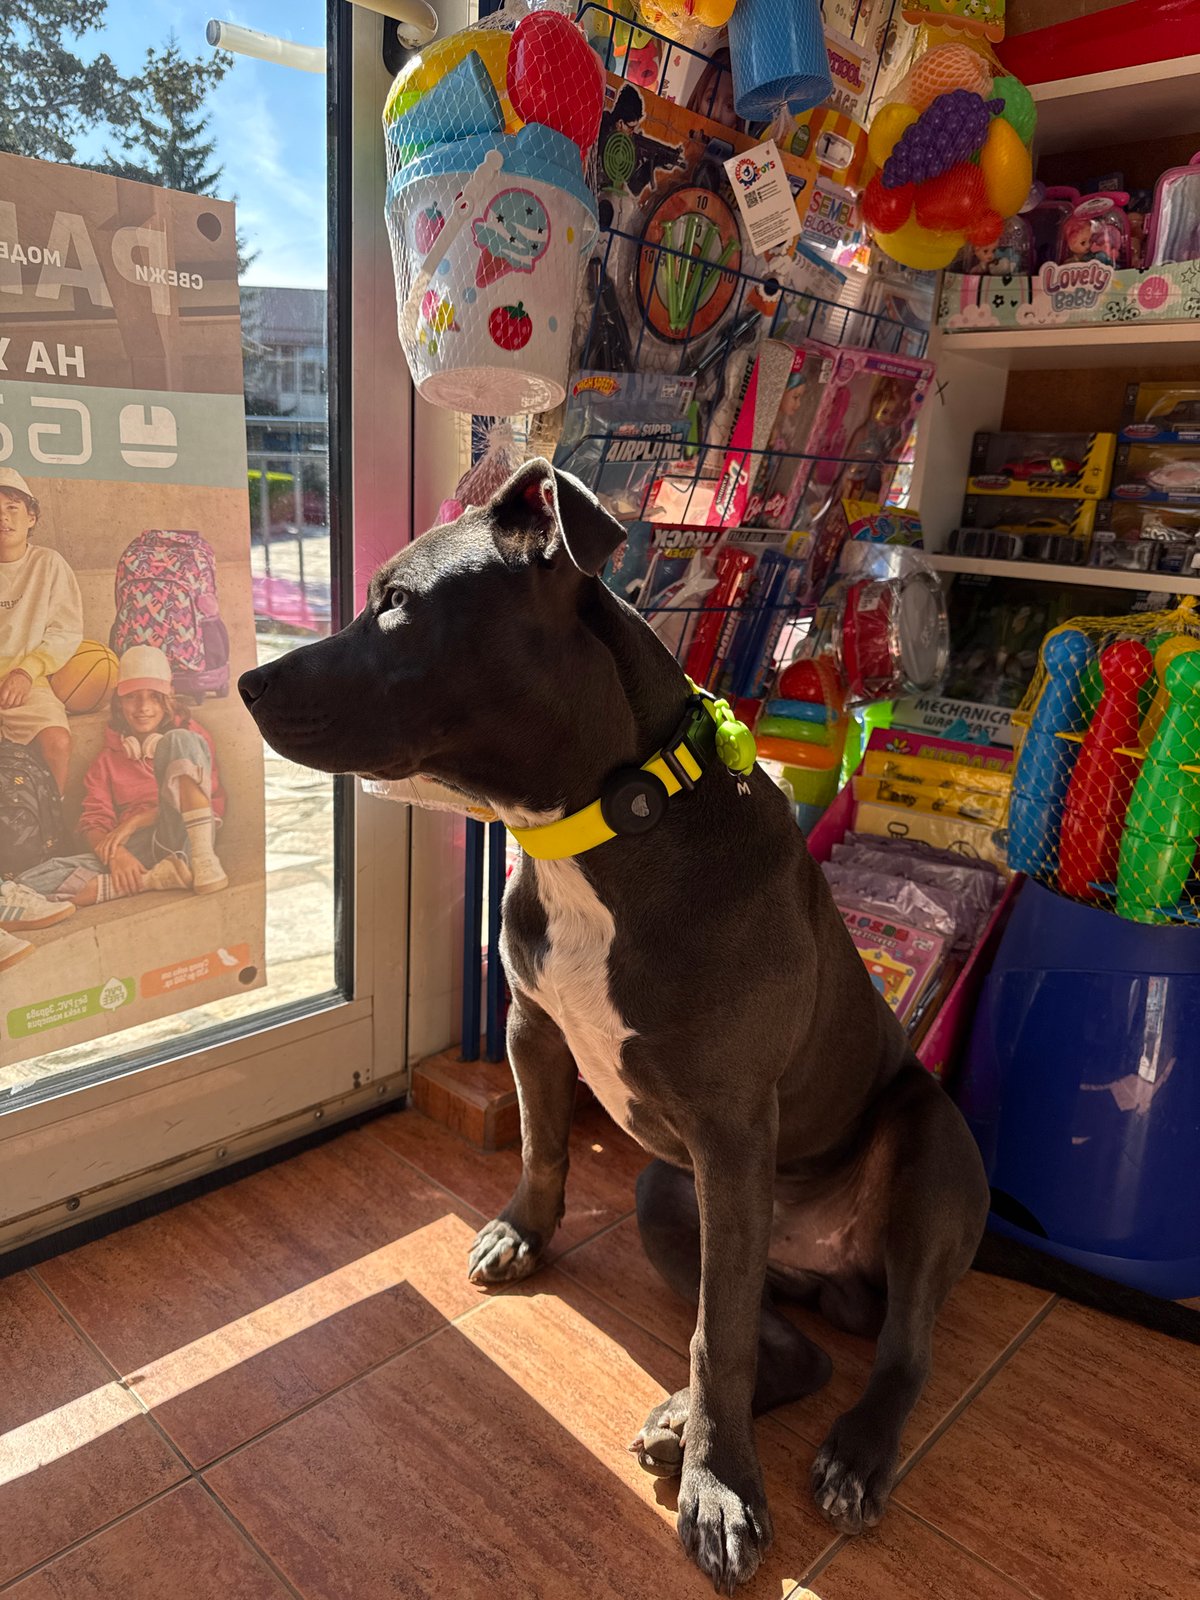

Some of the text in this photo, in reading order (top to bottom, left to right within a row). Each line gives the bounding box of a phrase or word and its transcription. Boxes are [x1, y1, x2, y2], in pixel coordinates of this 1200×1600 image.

[696, 195, 709, 210] 10
[642, 423, 672, 435] SUPER
[606, 432, 684, 462] AIRPLANE
[652, 529, 718, 549] TRUCK
[914, 697, 1010, 725] MECHANICA
[736, 781, 752, 797] M
